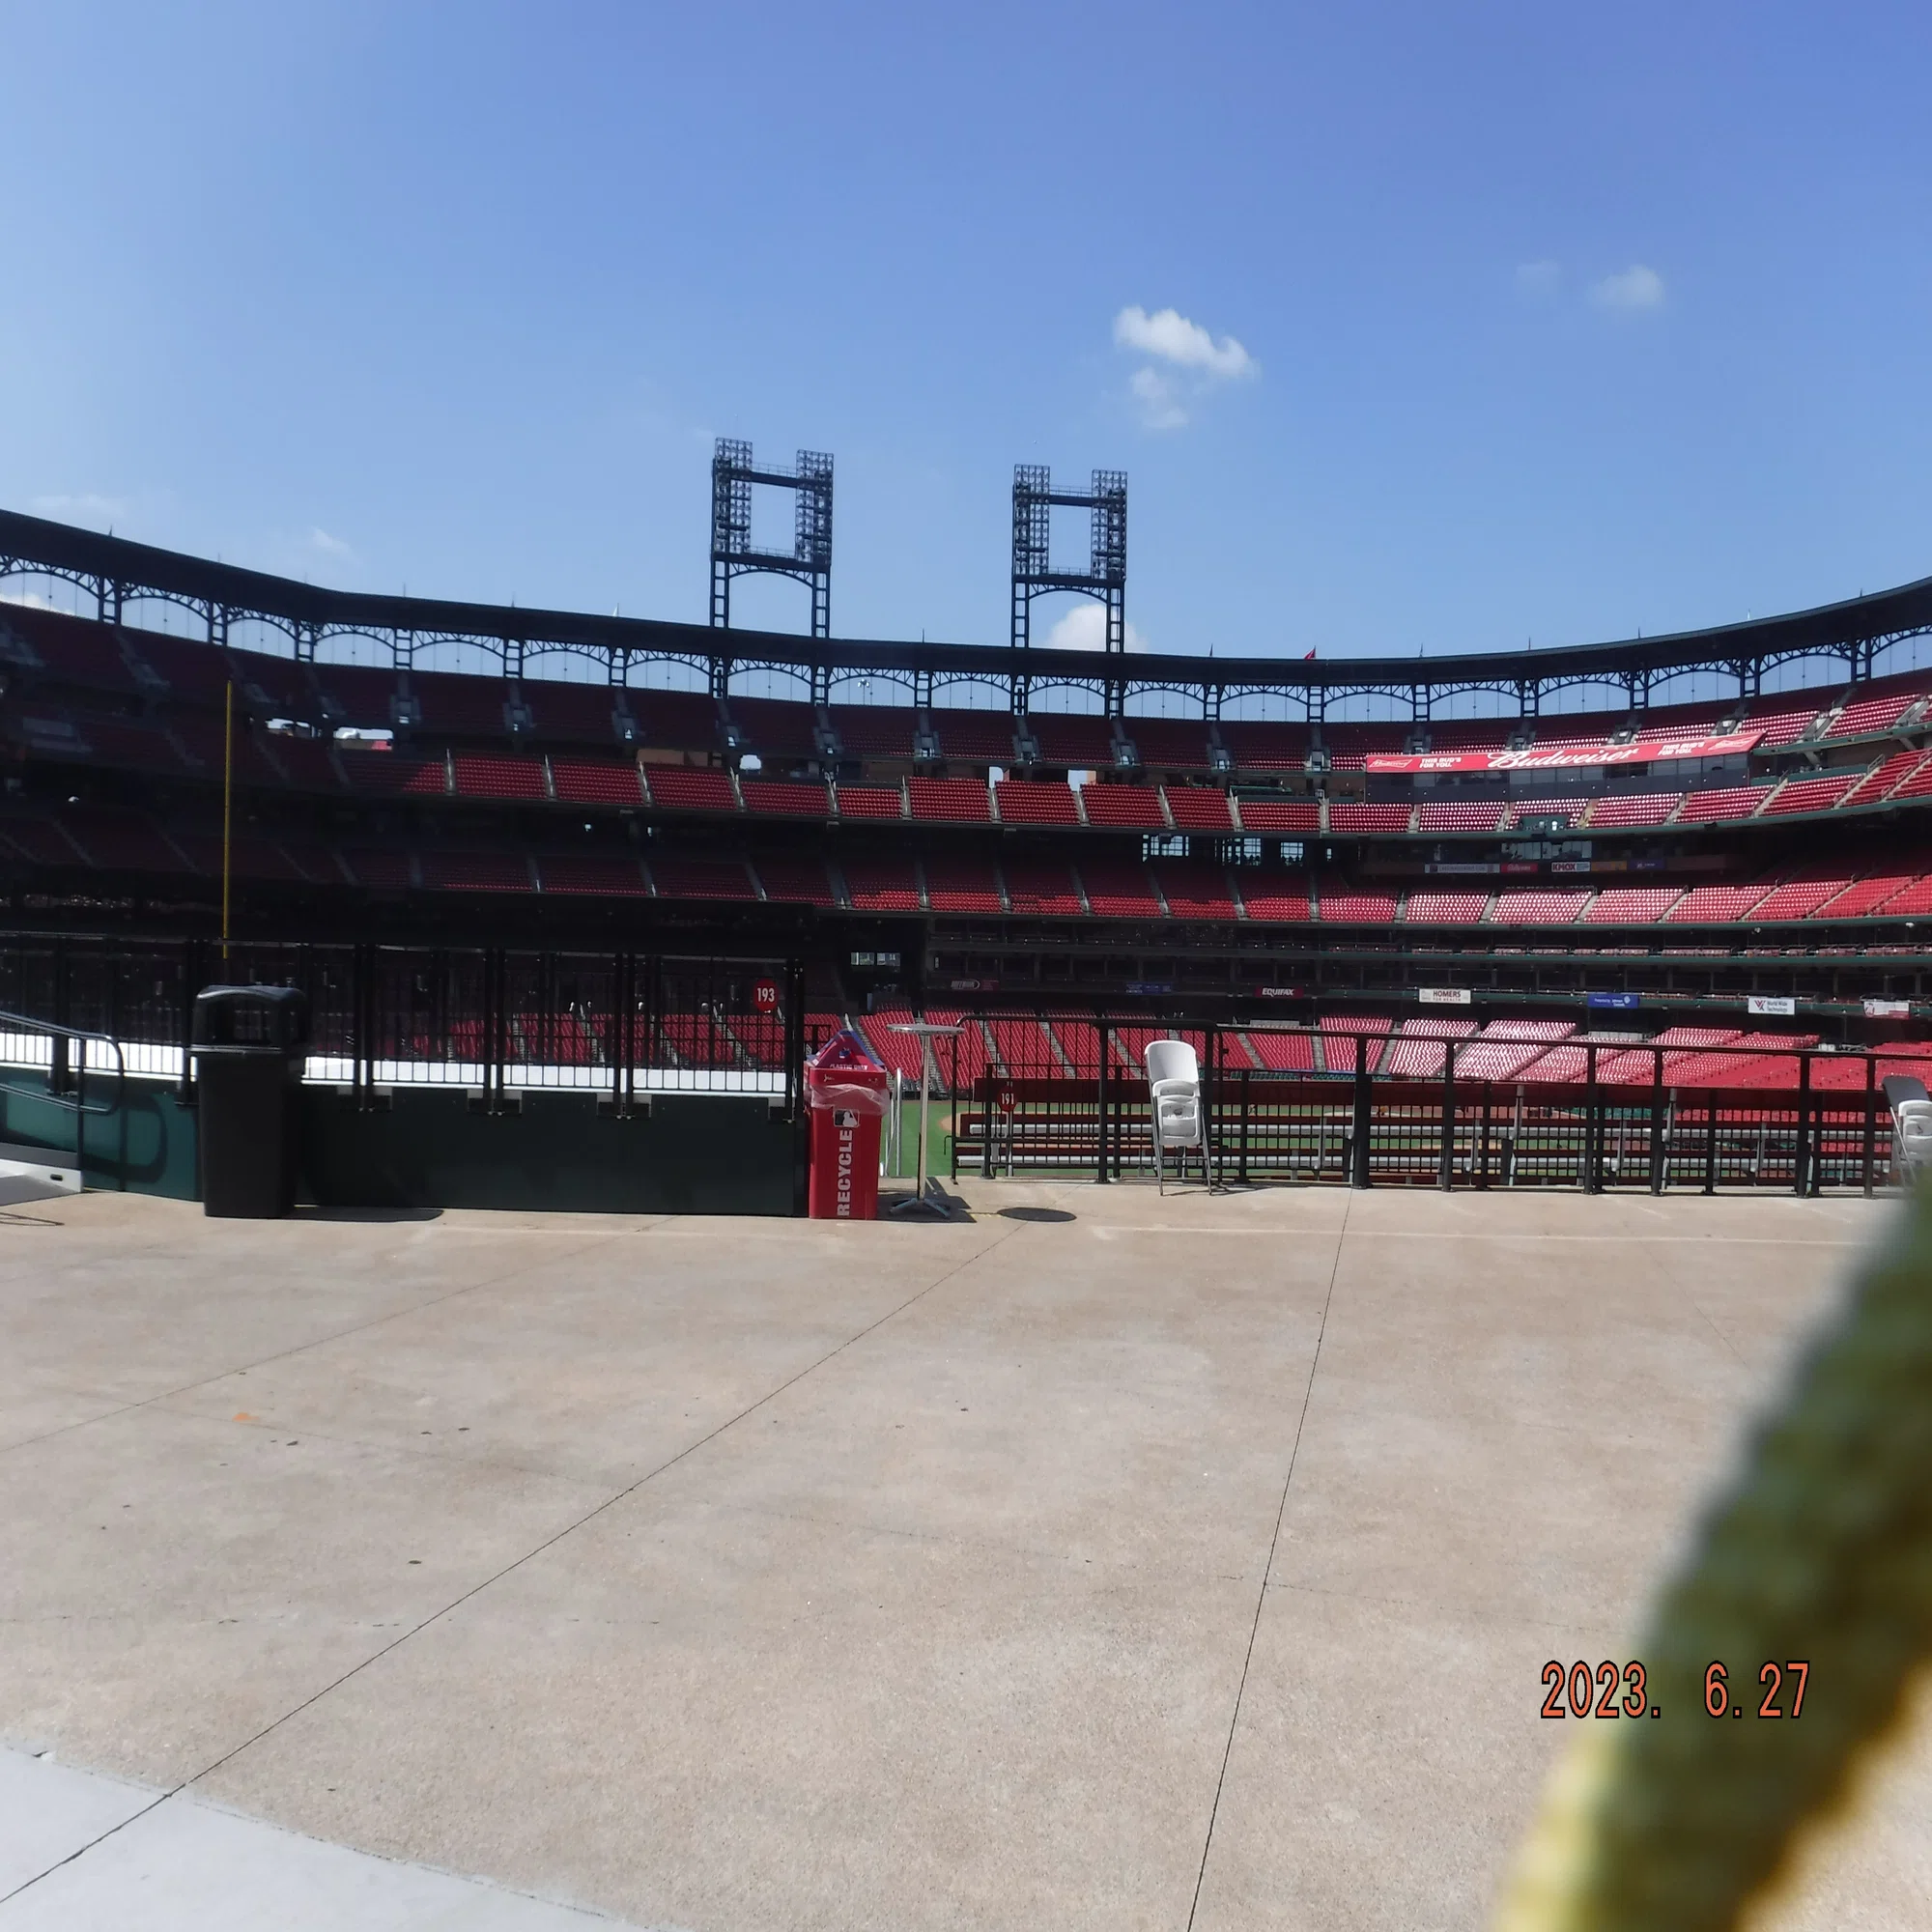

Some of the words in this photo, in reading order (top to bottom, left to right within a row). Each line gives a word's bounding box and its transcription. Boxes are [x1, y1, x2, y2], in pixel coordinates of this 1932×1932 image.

[1488, 748, 1639, 768] Budweiser
[756, 987, 775, 1002] 193
[1262, 987, 1294, 997] EQUIFAX
[1001, 1093, 1014, 1105] 191
[837, 1129, 853, 1216] RECYCLE
